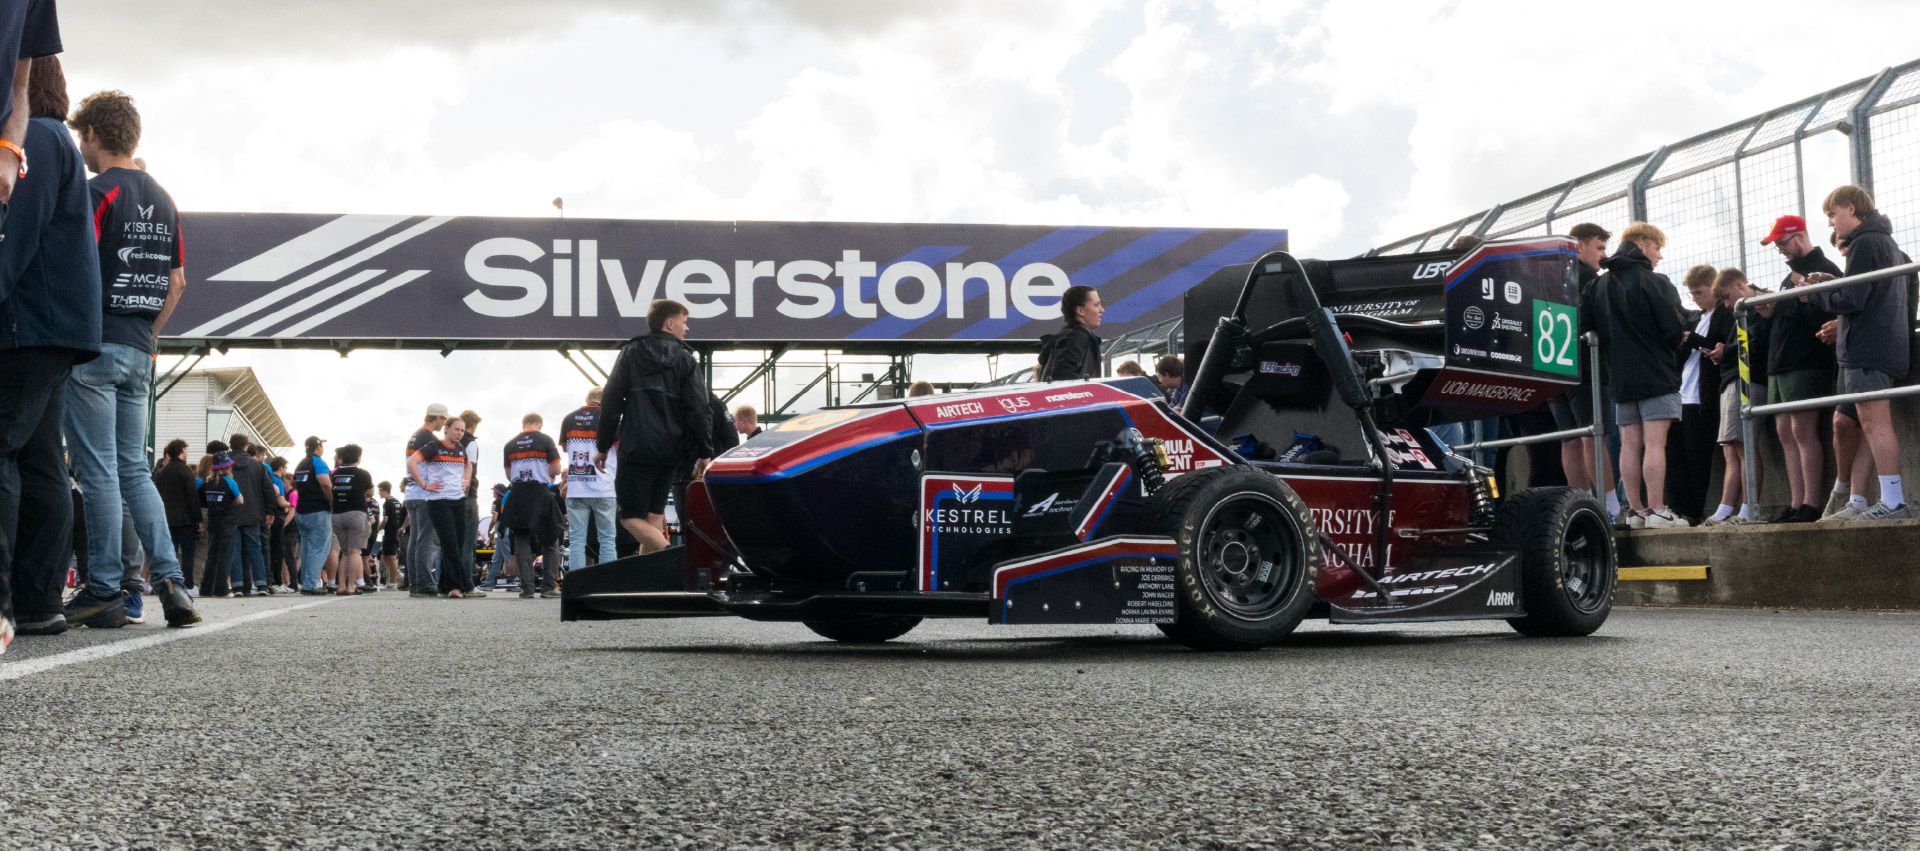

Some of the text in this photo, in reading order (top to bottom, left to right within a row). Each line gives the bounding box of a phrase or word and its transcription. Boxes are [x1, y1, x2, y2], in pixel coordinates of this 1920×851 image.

[462, 236, 1072, 320] Silverstone
[1537, 310, 1574, 367] 82
[1441, 381, 1537, 402] UOB MAKERSPACE
[936, 401, 984, 418] AIRTECH
[997, 396, 1031, 414] igus
[925, 508, 1012, 524] KESTREL
[926, 525, 1012, 535] TECHNOLOGIES
[1120, 565, 1175, 573] RACING IN MEMORY OF
[1141, 574, 1151, 582] JOE
[1377, 563, 1496, 584] AIRTECH
[1127, 600, 1175, 608] ROBERT HASELDINE
[1486, 588, 1516, 607] ARRK
